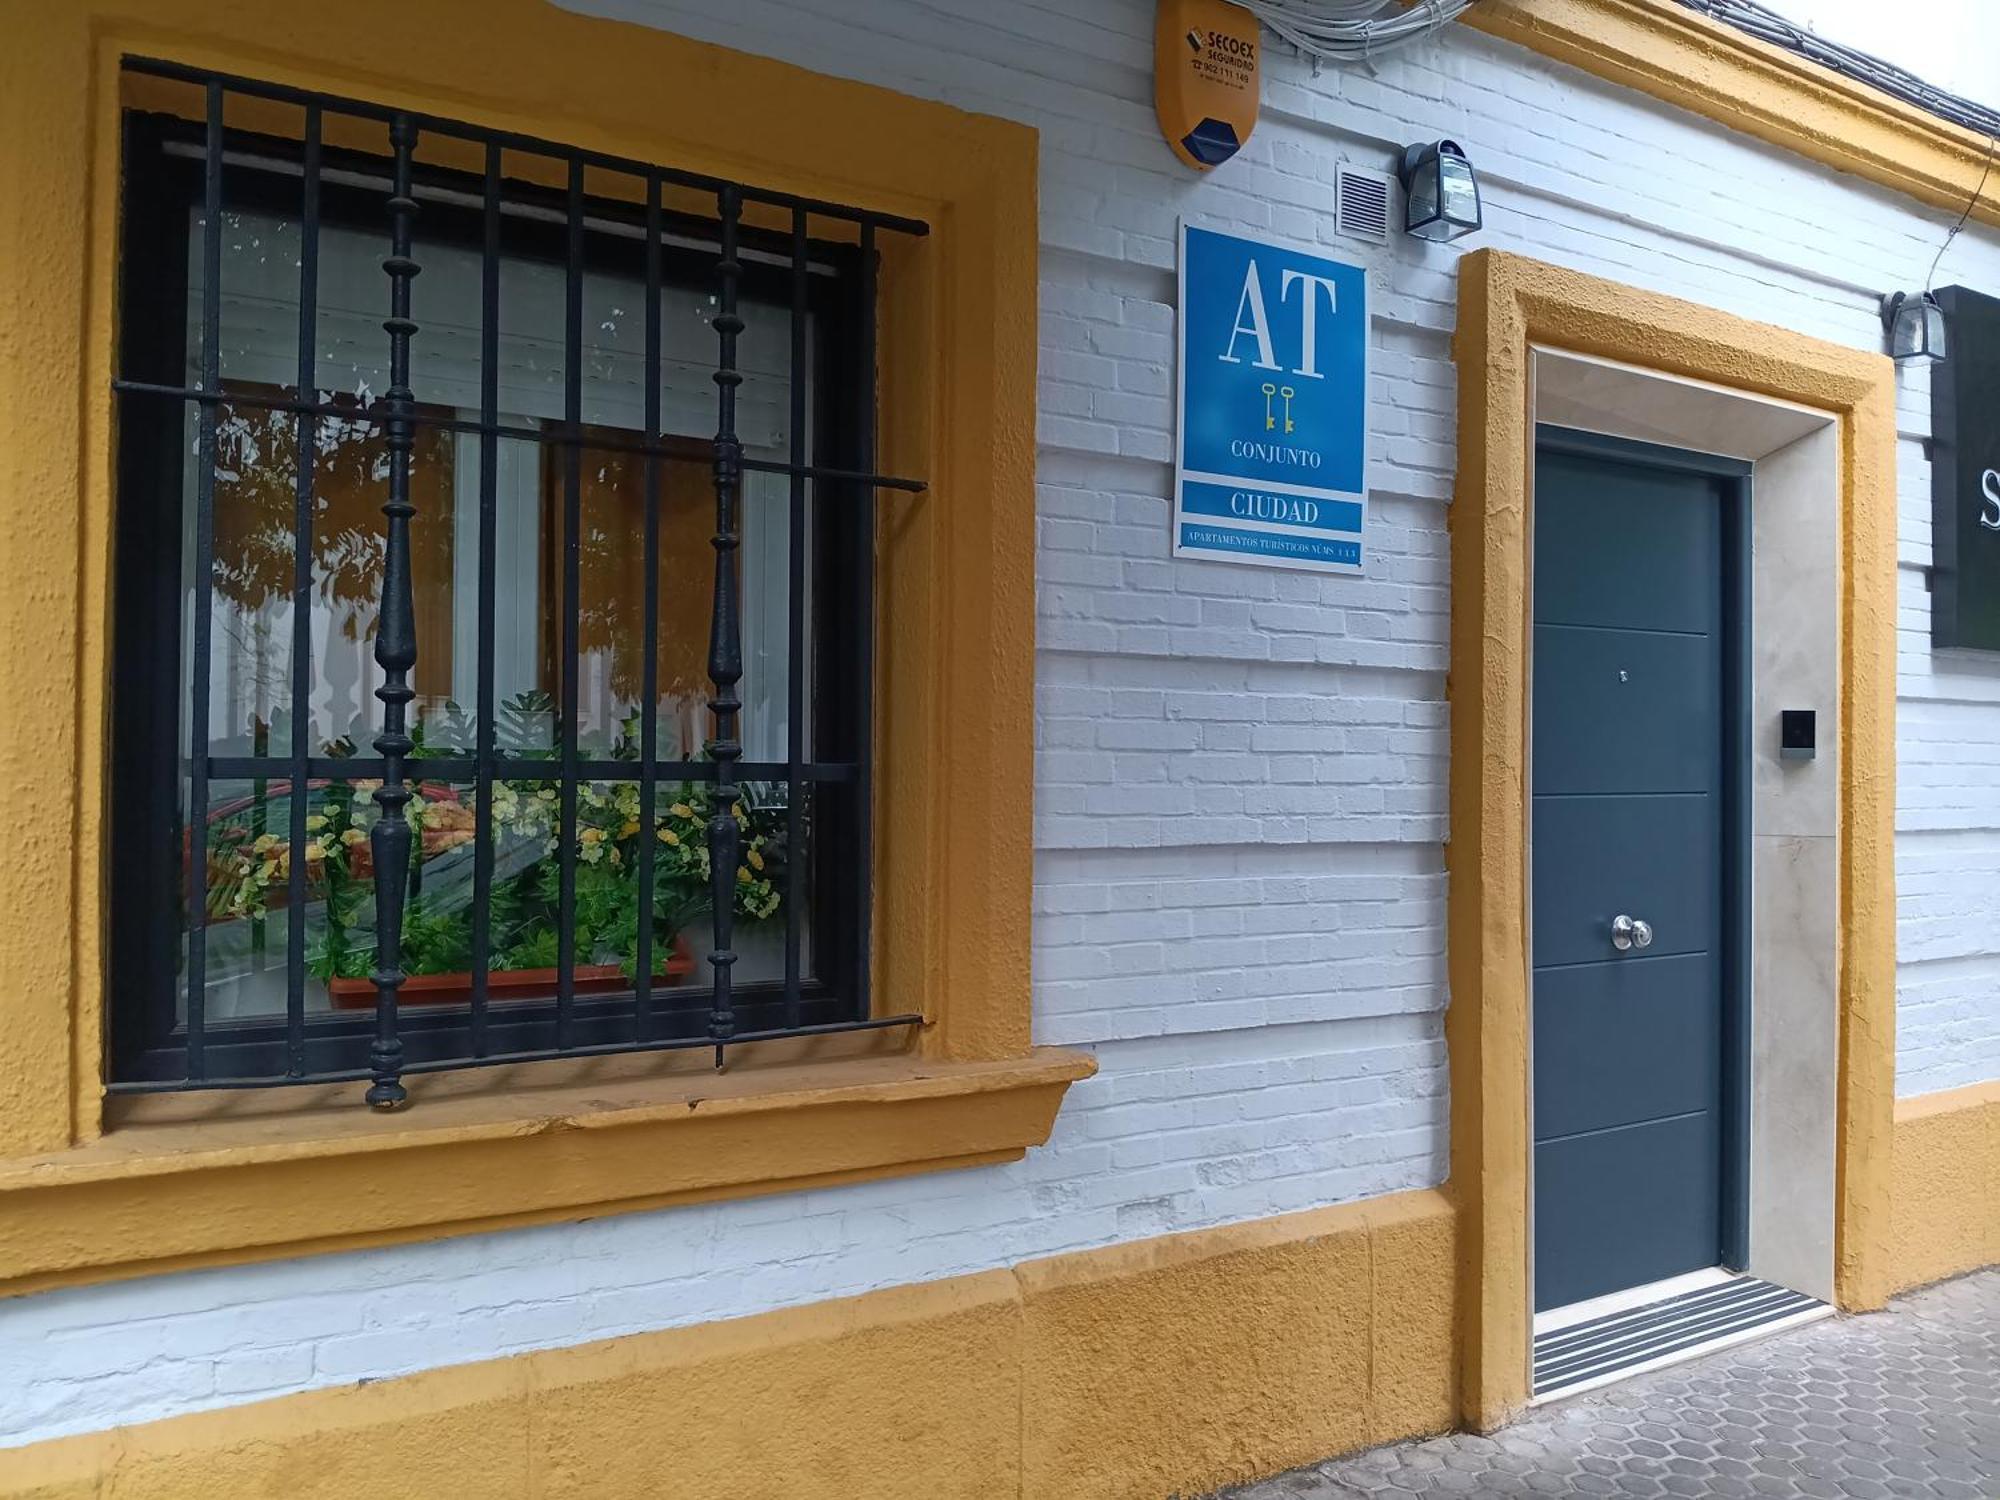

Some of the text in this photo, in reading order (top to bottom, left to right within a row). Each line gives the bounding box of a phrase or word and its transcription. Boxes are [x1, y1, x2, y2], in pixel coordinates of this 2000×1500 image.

[1208, 32, 1254, 60] SECOEX
[1208, 49, 1254, 72] SEGURIDAD
[1219, 259, 1336, 379] AT
[1231, 439, 1321, 469] CONJUNTO
[1231, 491, 1318, 524] CIUDAD
[1188, 531, 1258, 547] APARTAMENTOS
